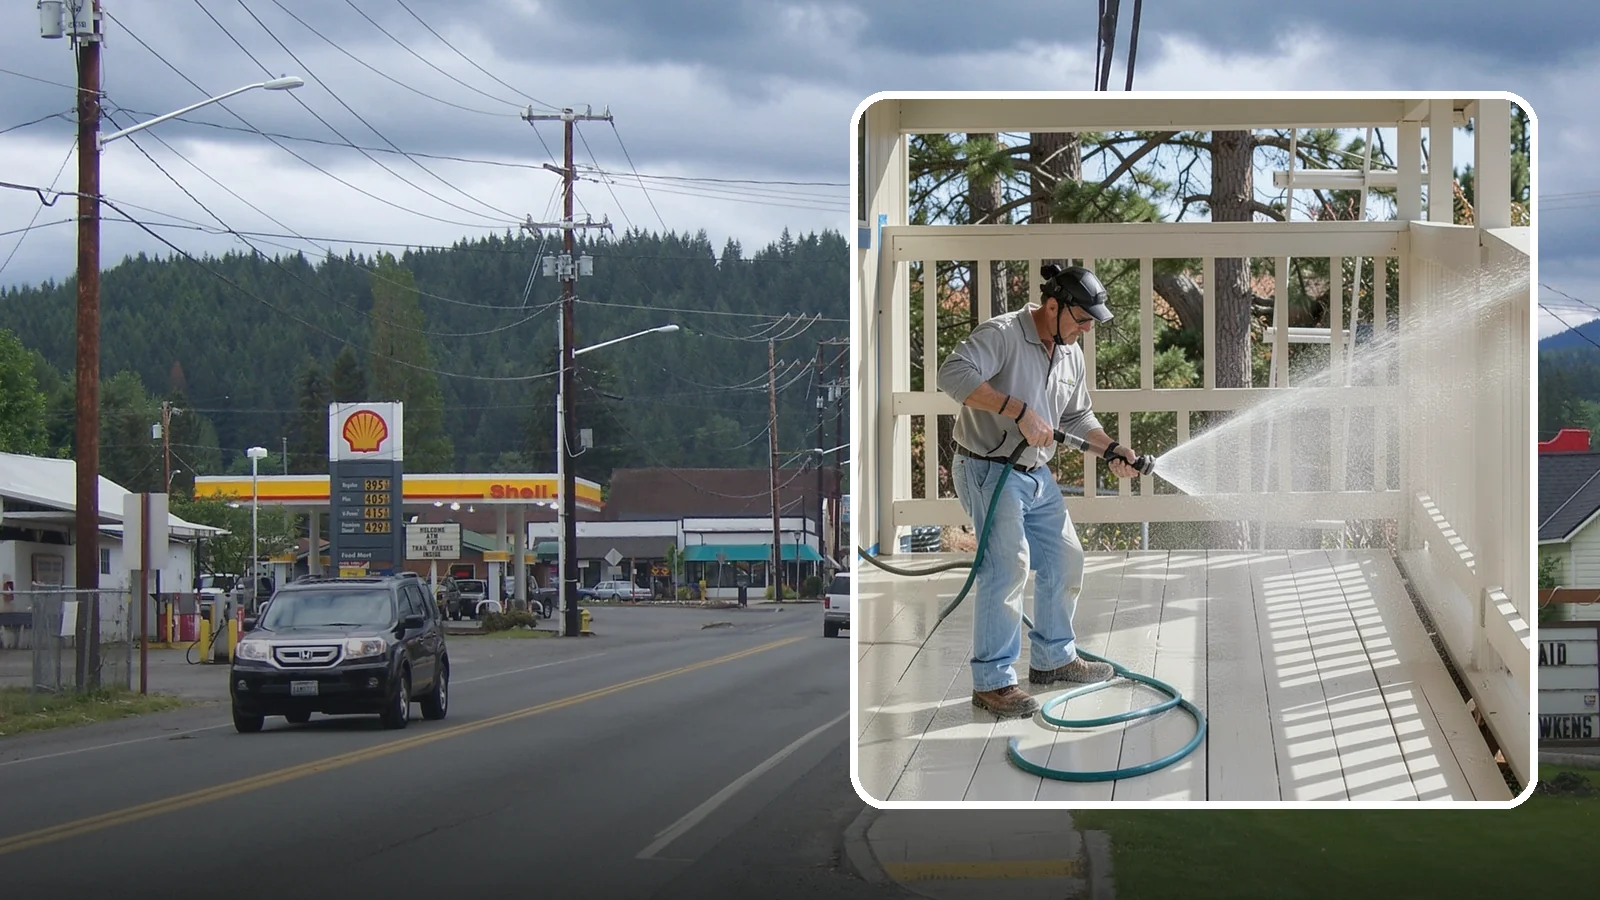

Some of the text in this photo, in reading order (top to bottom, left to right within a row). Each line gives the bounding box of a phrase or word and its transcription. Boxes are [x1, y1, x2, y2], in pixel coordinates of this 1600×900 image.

[366, 480, 383, 490] 395
[490, 484, 547, 499] Shell
[365, 494, 383, 504] 405
[365, 508, 383, 518] 415
[366, 522, 383, 532] 429
[1538, 642, 1567, 665] AID
